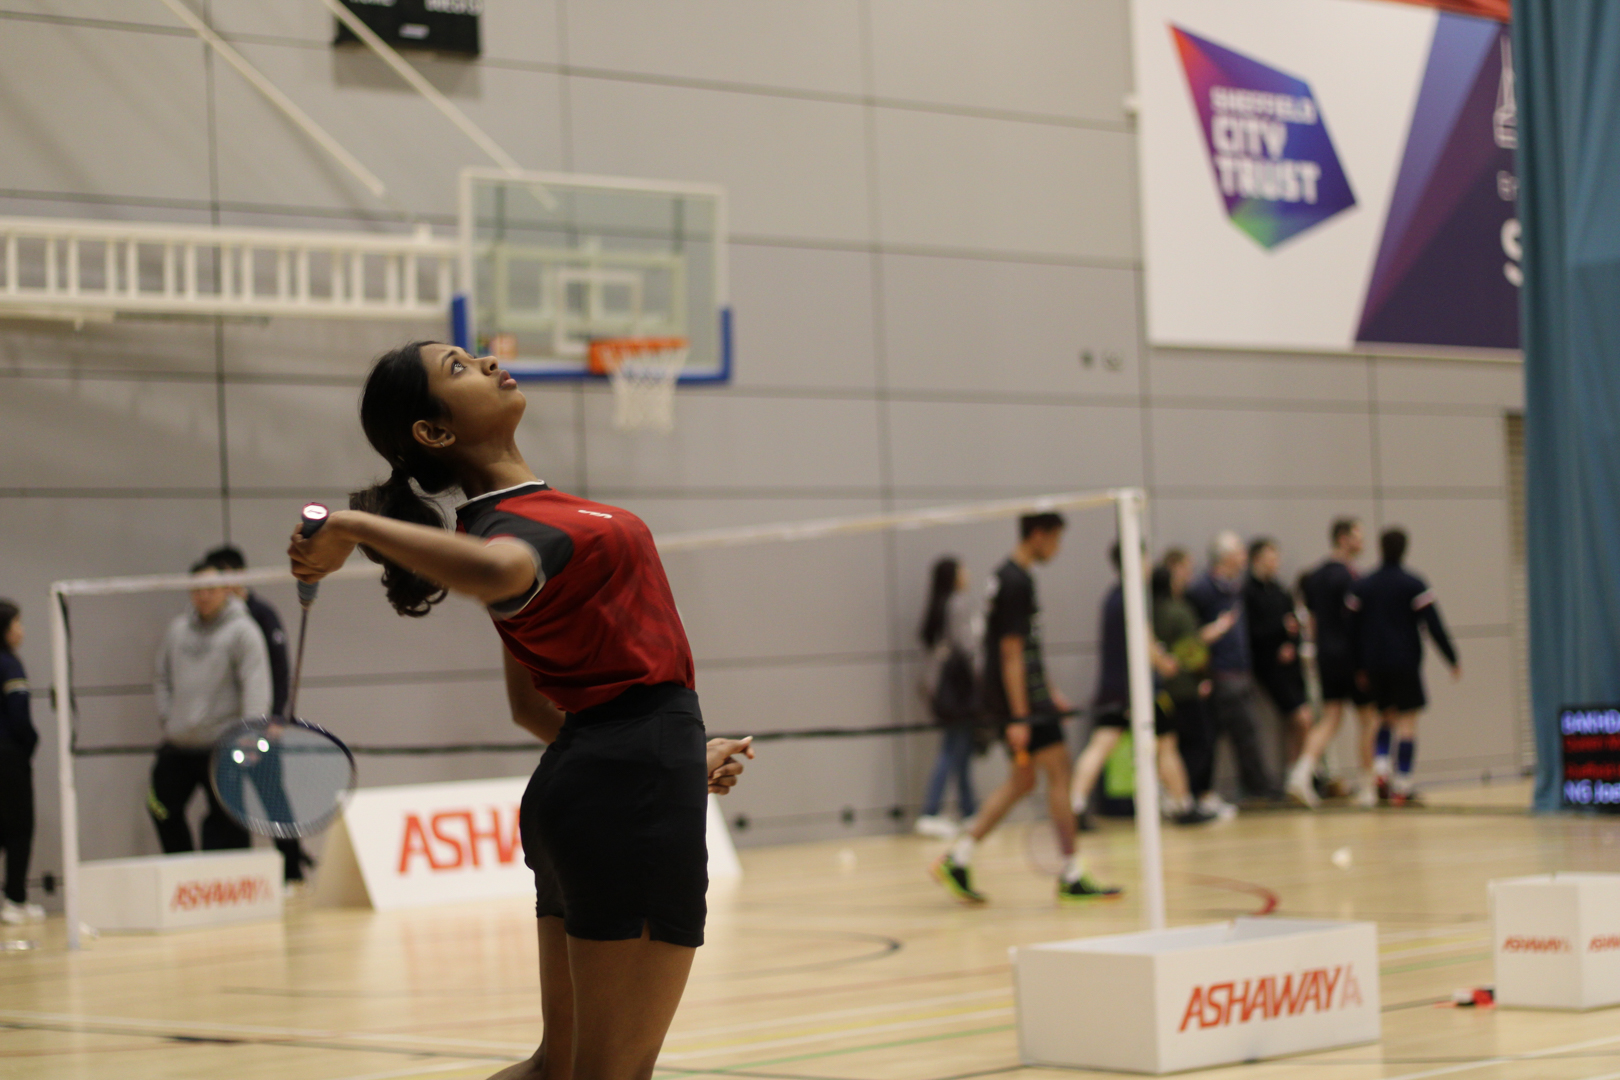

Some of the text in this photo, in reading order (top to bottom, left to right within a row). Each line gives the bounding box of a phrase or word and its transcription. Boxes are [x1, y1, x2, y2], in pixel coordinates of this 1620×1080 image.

[1212, 116, 1286, 158] CITY
[1215, 156, 1320, 203] TRUST
[1179, 966, 1342, 1033] ASHAWAY
